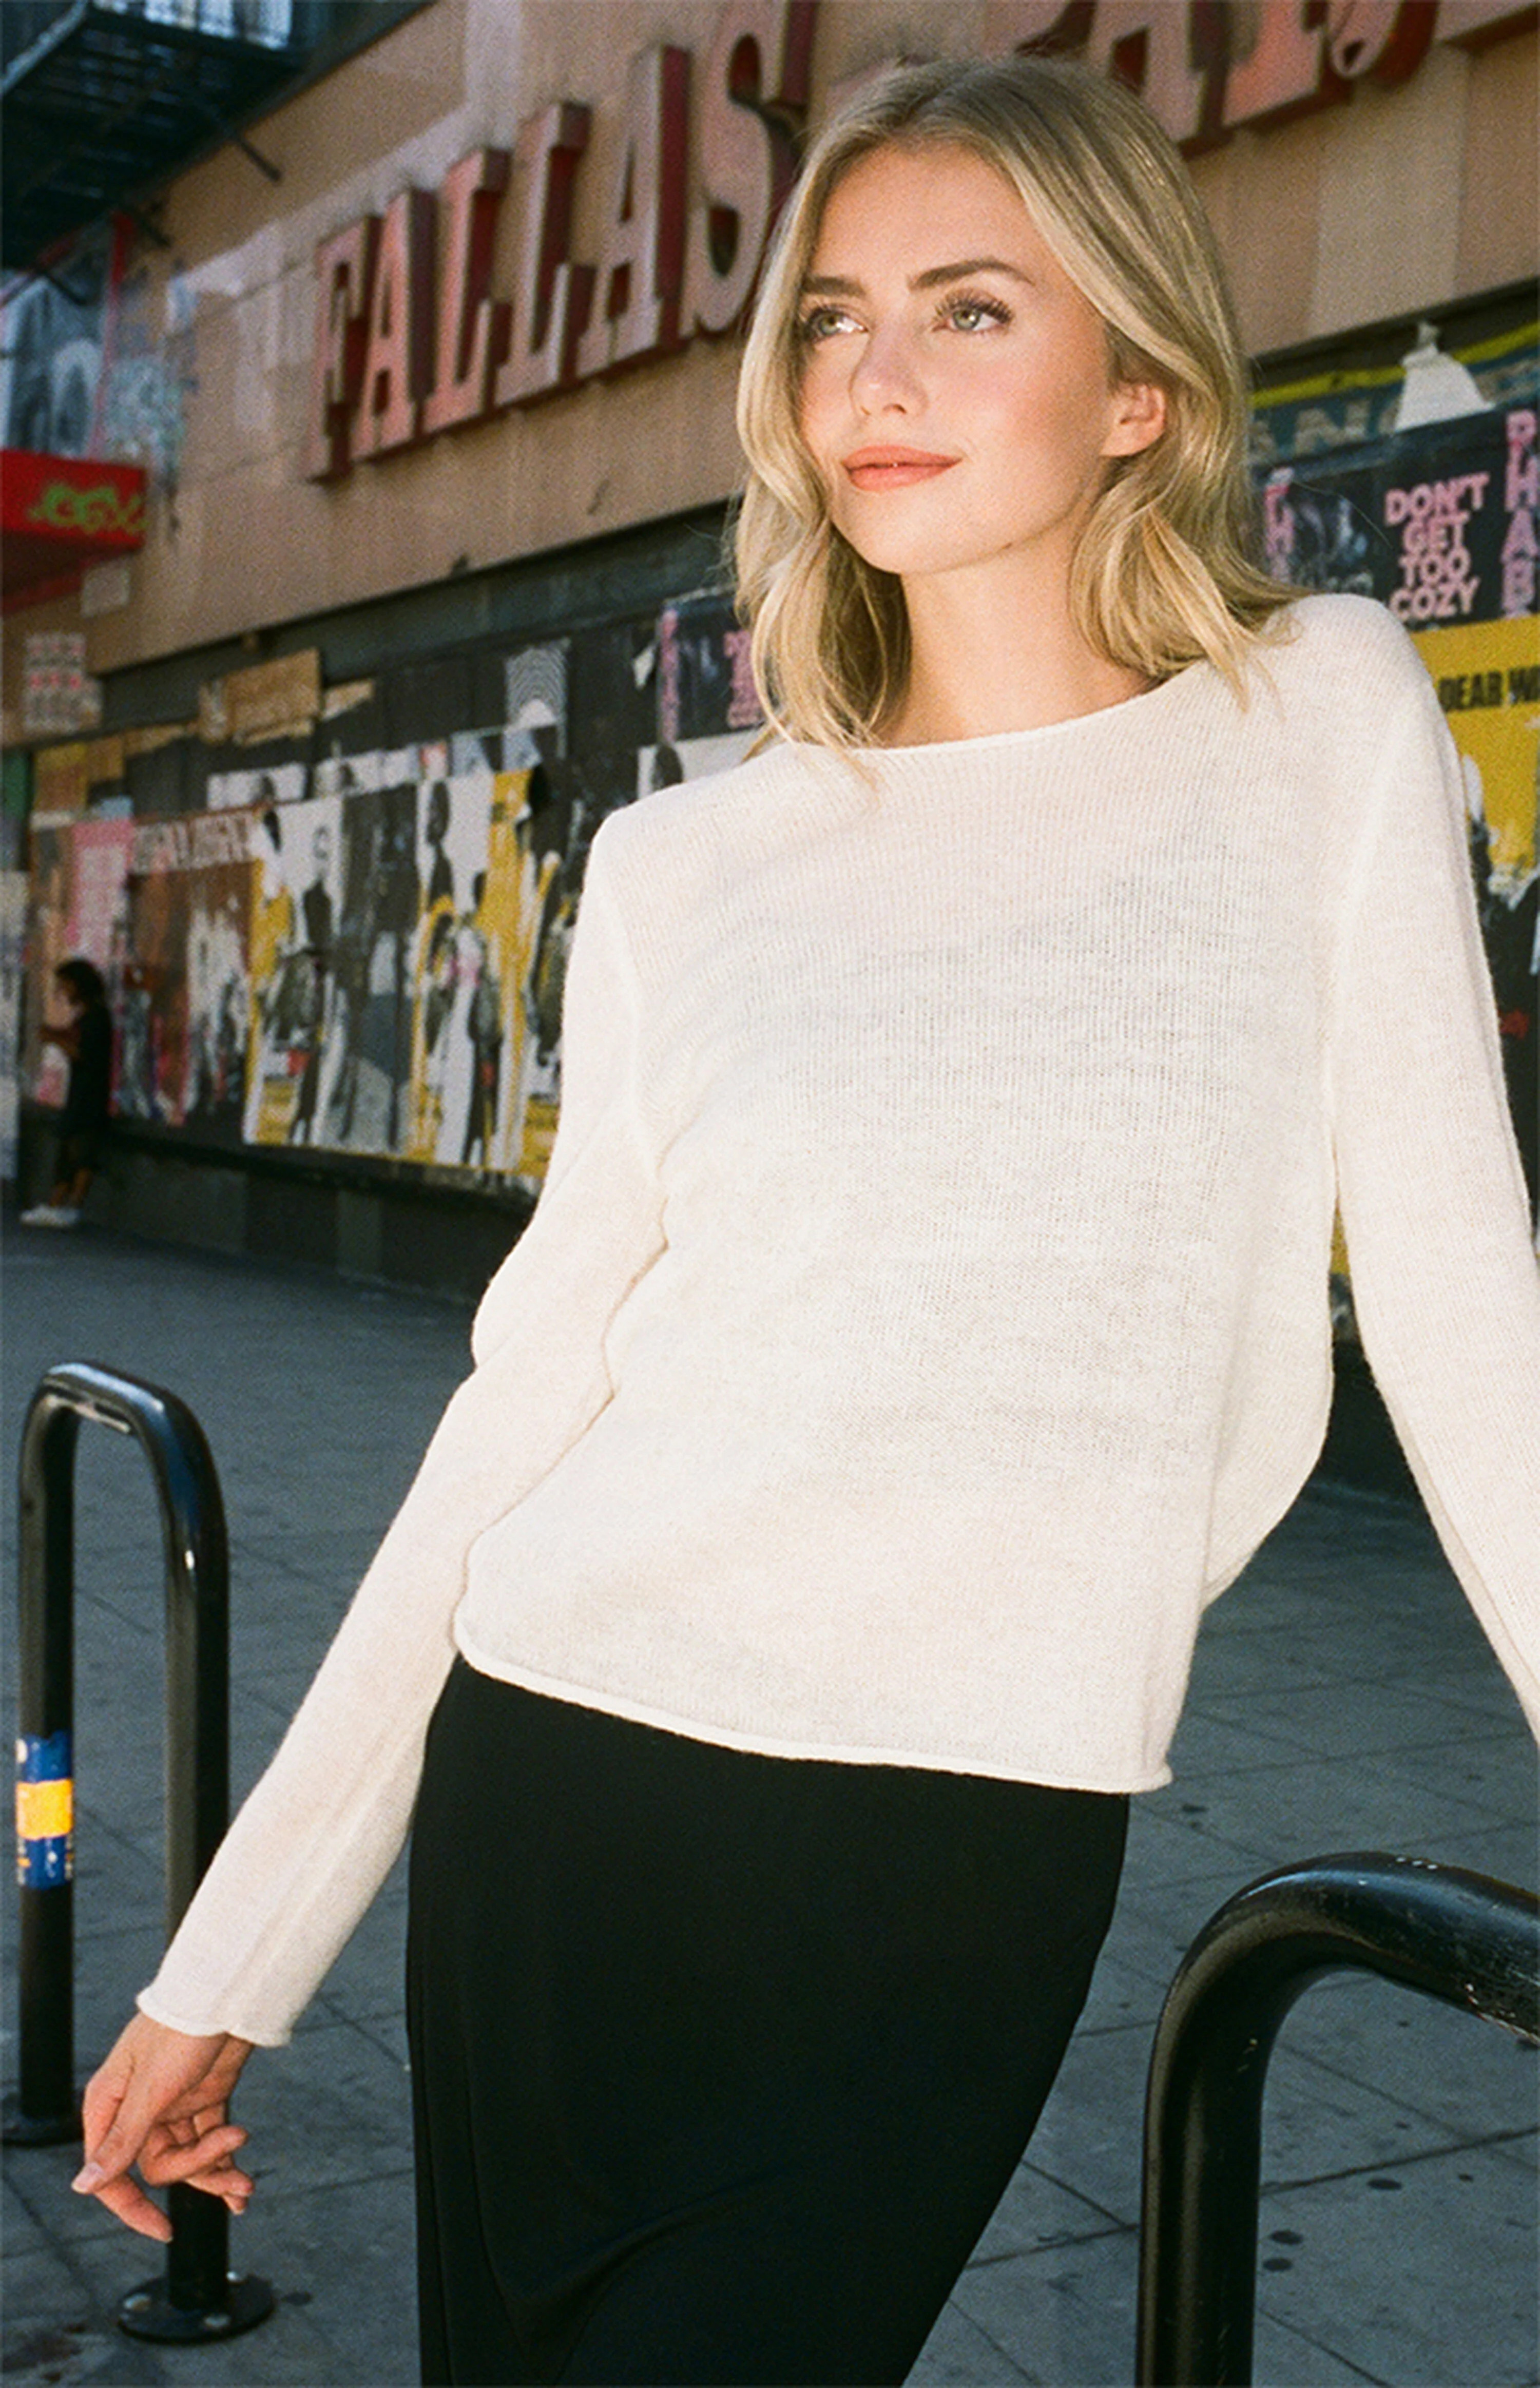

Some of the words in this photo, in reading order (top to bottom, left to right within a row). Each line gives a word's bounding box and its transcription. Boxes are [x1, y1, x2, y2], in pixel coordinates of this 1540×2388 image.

[307, 0, 798, 480] FALLAS
[1403, 511, 1470, 554] GET
[1398, 546, 1471, 588] TOO
[1389, 576, 1480, 622] COZY
